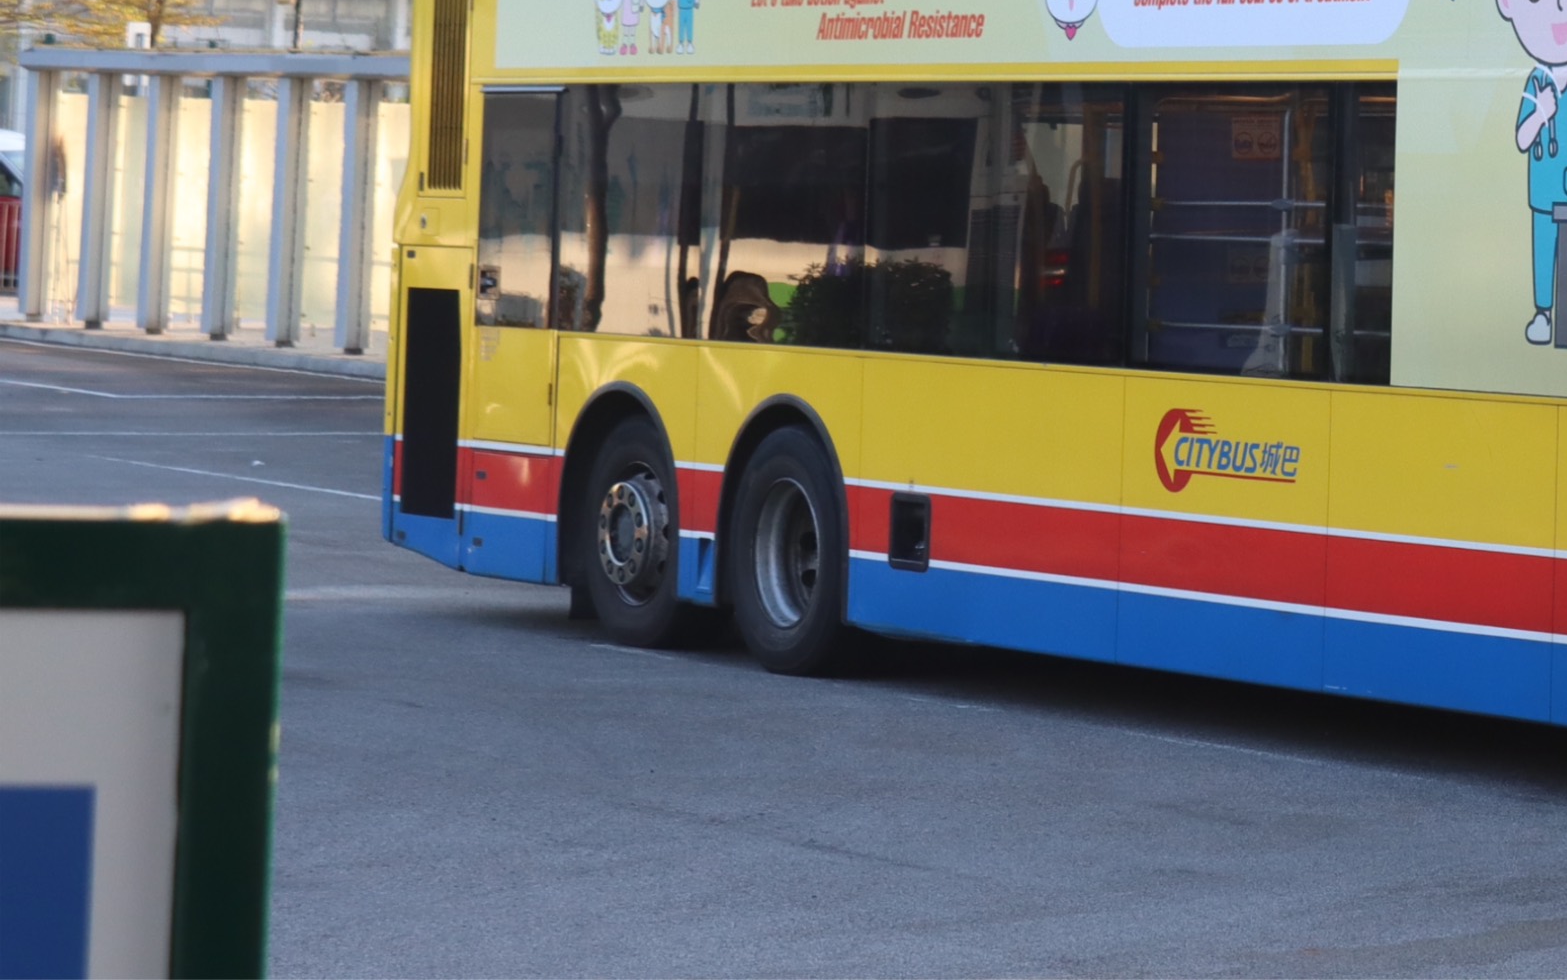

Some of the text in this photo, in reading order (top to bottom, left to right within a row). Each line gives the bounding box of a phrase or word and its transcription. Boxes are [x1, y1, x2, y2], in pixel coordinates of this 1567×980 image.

[816, 9, 985, 40] Antimicrobial Resistance
[1174, 436, 1300, 477] CITYBUS 城巴
